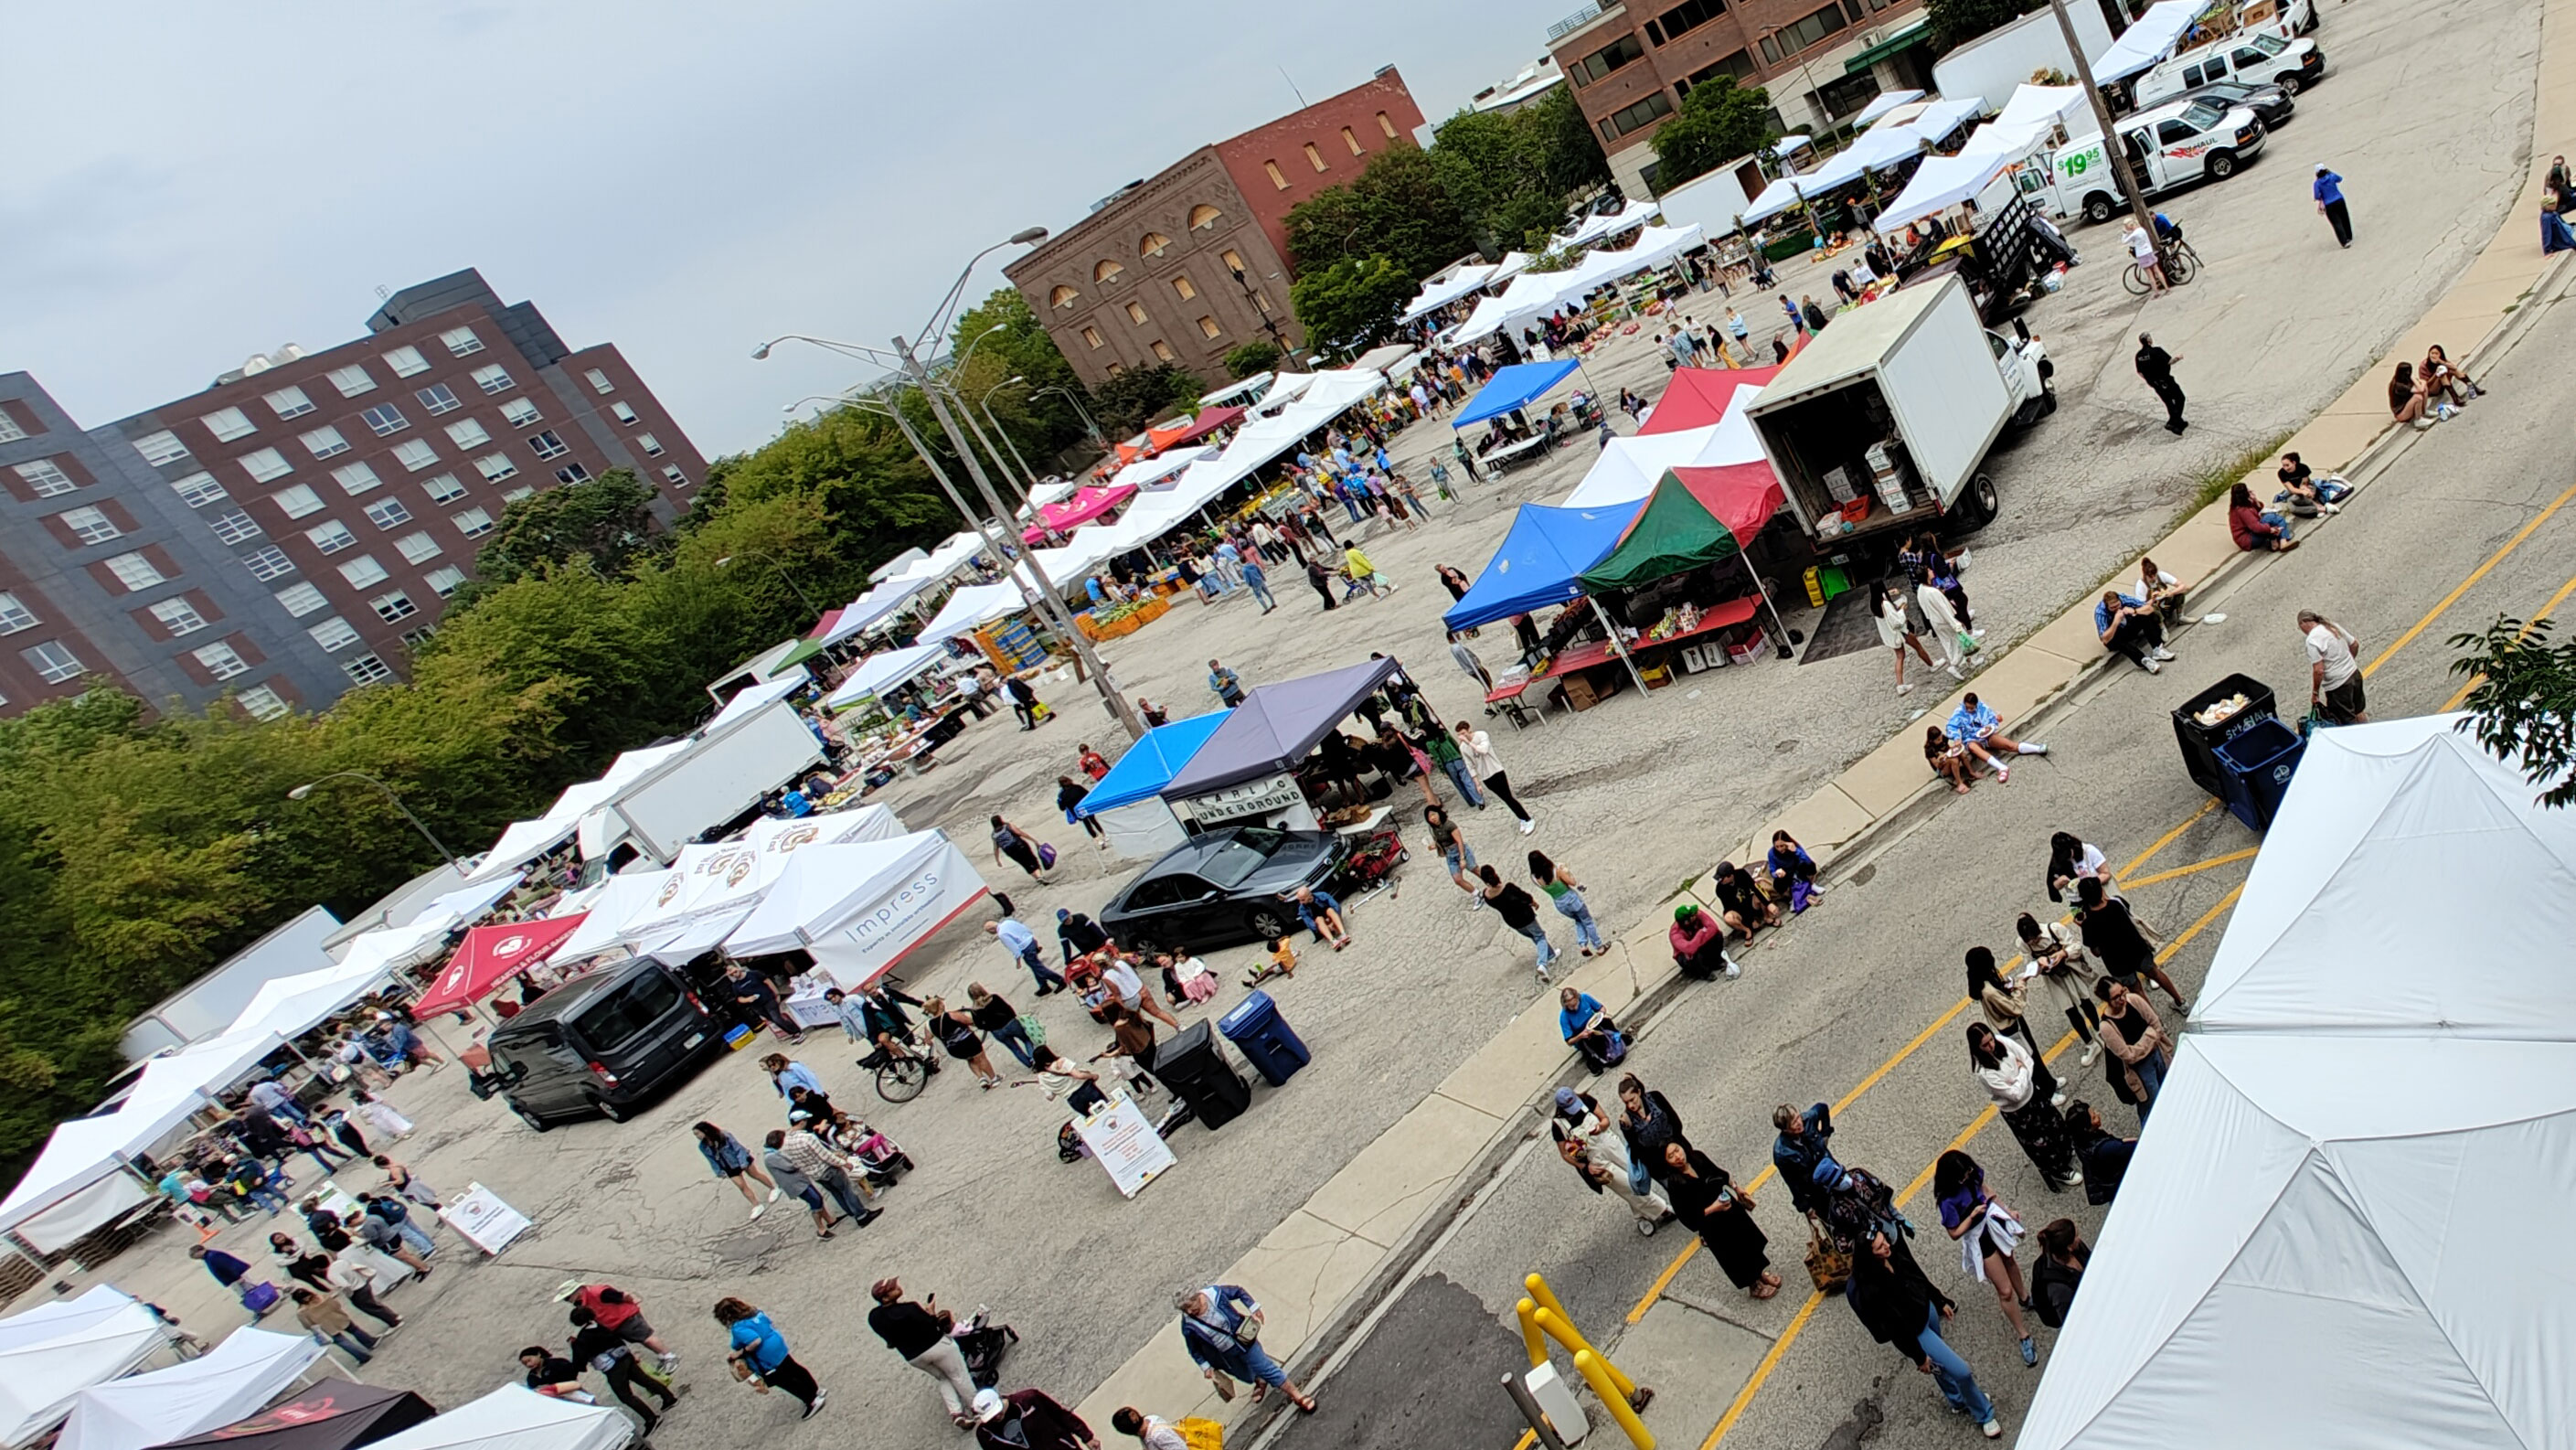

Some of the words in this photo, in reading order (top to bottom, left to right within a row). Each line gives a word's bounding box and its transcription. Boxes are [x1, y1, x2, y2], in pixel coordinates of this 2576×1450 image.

[1199, 791, 1300, 820] UNDERGROUND
[845, 872, 938, 943] Impress
[490, 966, 518, 988] HEARTS
[527, 944, 550, 965] FLOUR
